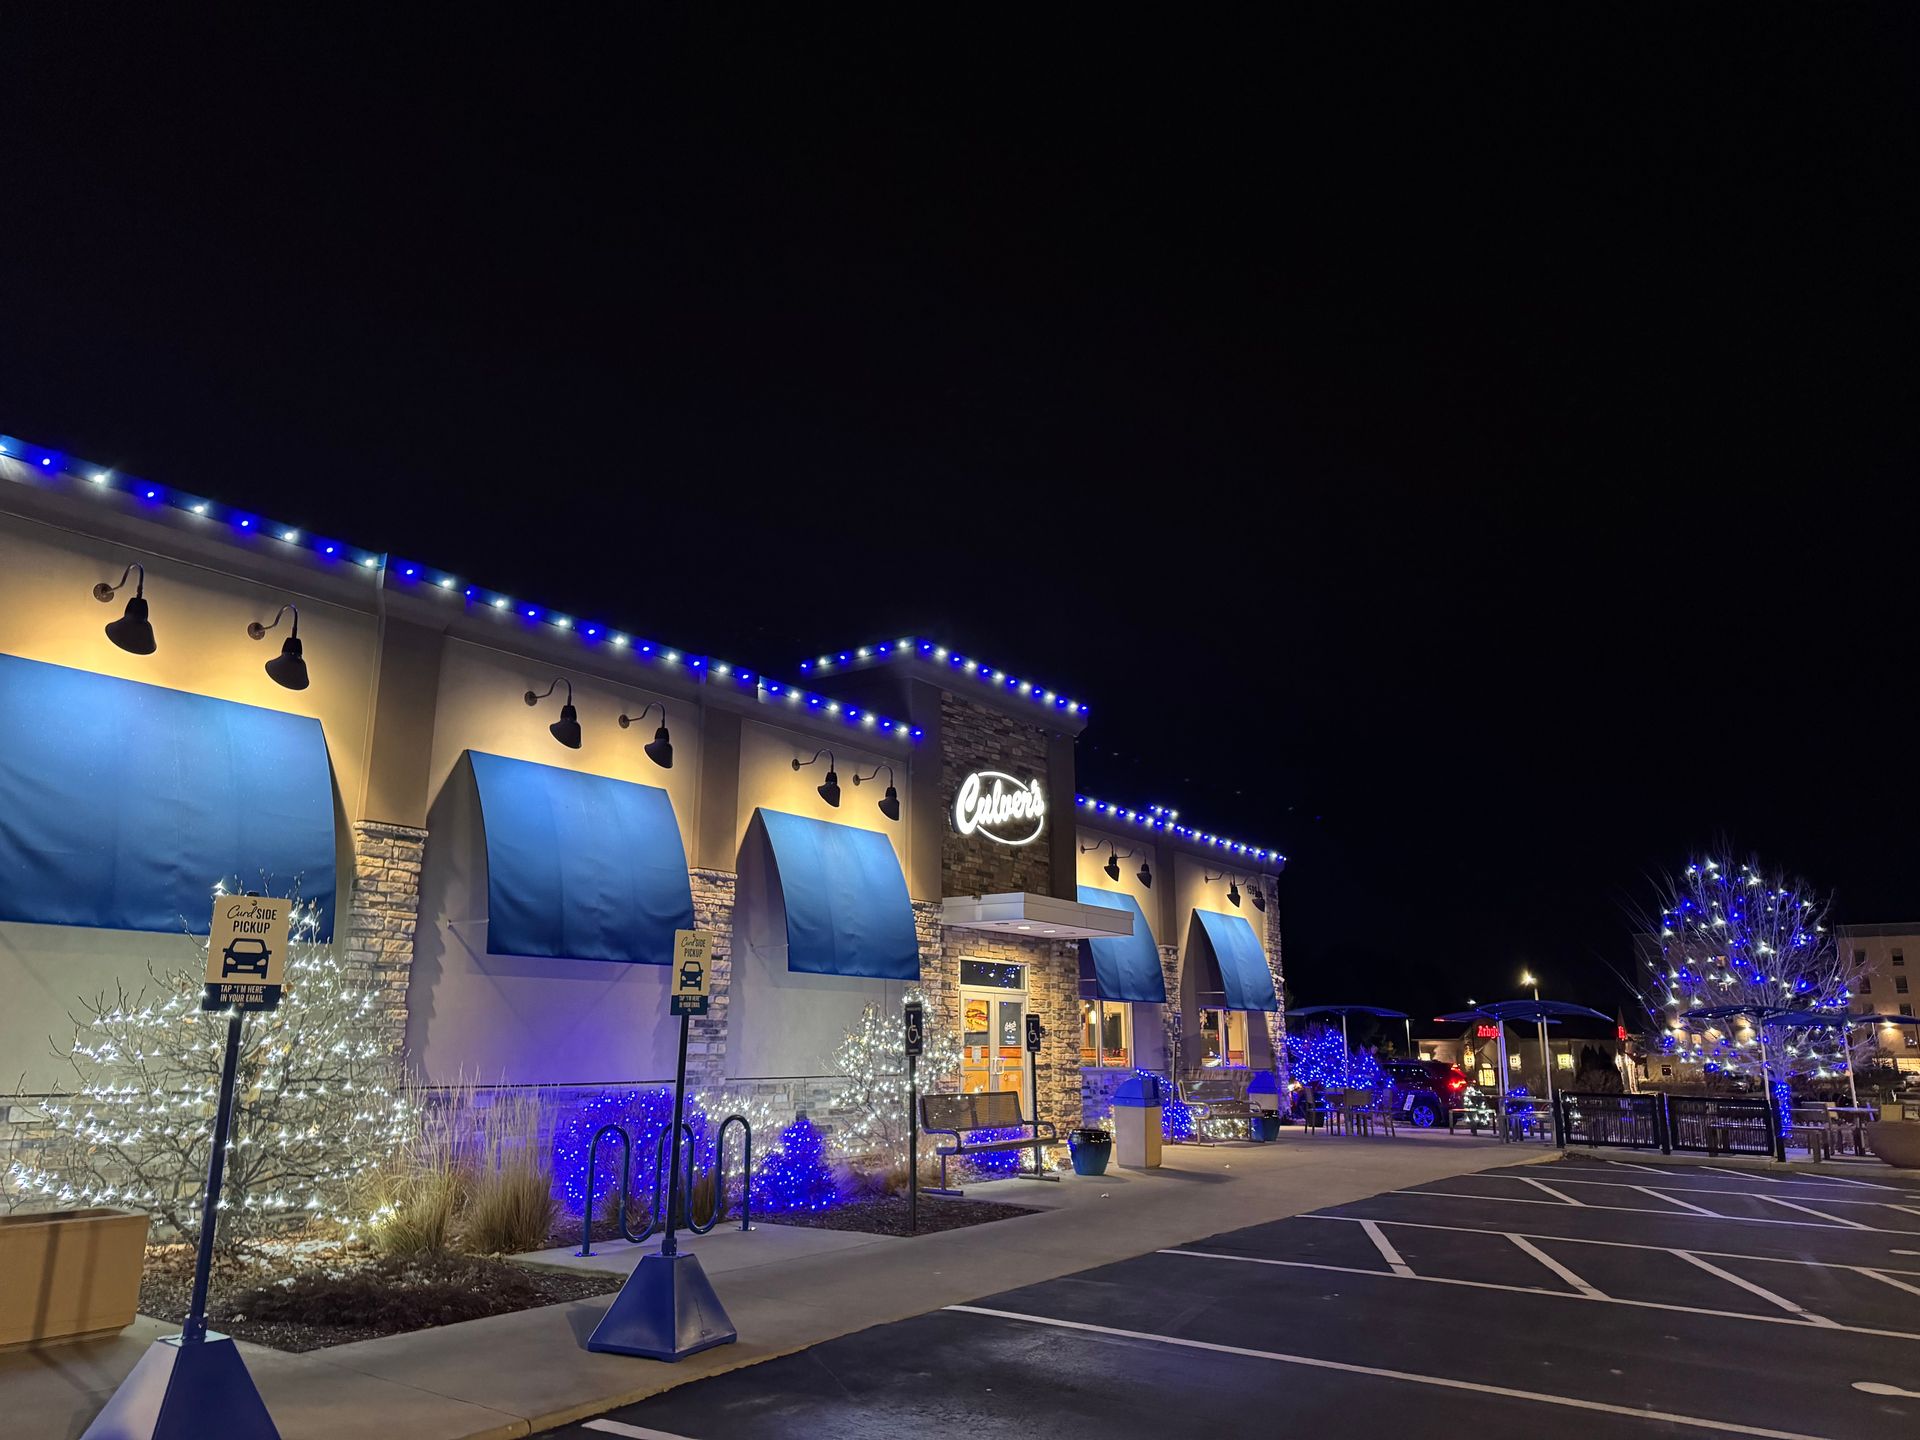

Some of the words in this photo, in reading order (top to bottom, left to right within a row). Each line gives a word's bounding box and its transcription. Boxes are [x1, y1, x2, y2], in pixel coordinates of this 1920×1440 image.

[956, 773, 1045, 834] Culver's
[233, 920, 271, 934] PICKUP
[684, 948, 703, 958] PICKUP
[220, 984, 232, 993] TAP
[220, 993, 227, 1002] IN
[228, 994, 245, 1002] YOUR
[245, 994, 264, 1003] EMAIL
